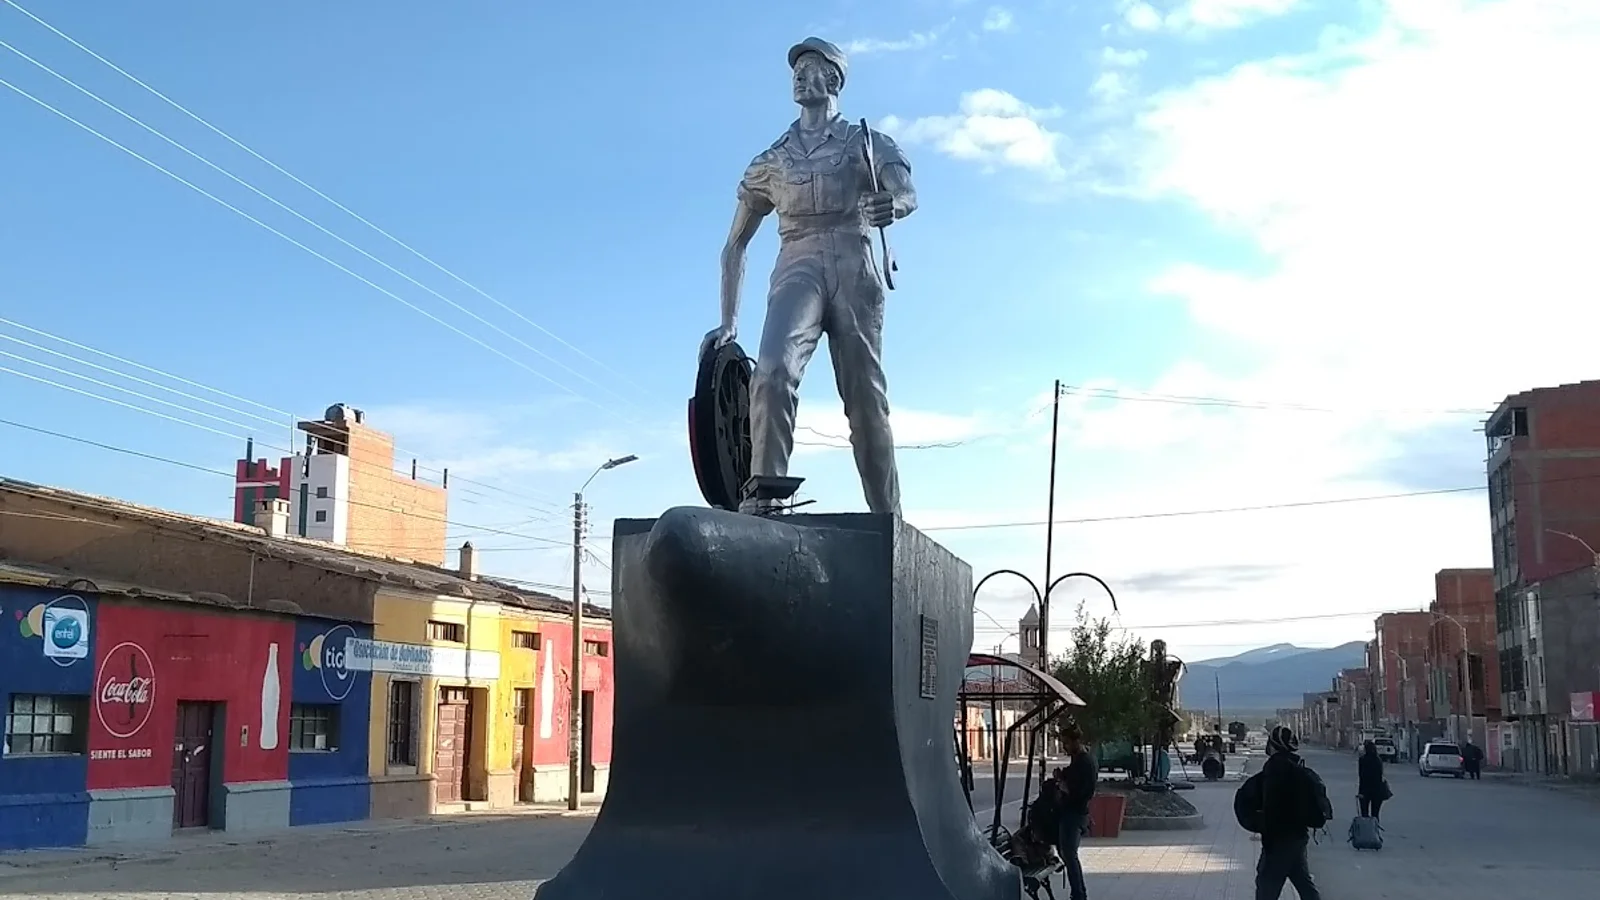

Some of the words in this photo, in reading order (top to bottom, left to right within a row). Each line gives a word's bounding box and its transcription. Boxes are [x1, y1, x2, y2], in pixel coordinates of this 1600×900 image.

[325, 646, 348, 680] tig
[101, 676, 152, 703] Coca-Cola
[90, 749, 117, 760] SIENTE
[117, 749, 127, 759] EL
[128, 748, 152, 758] SABOR
